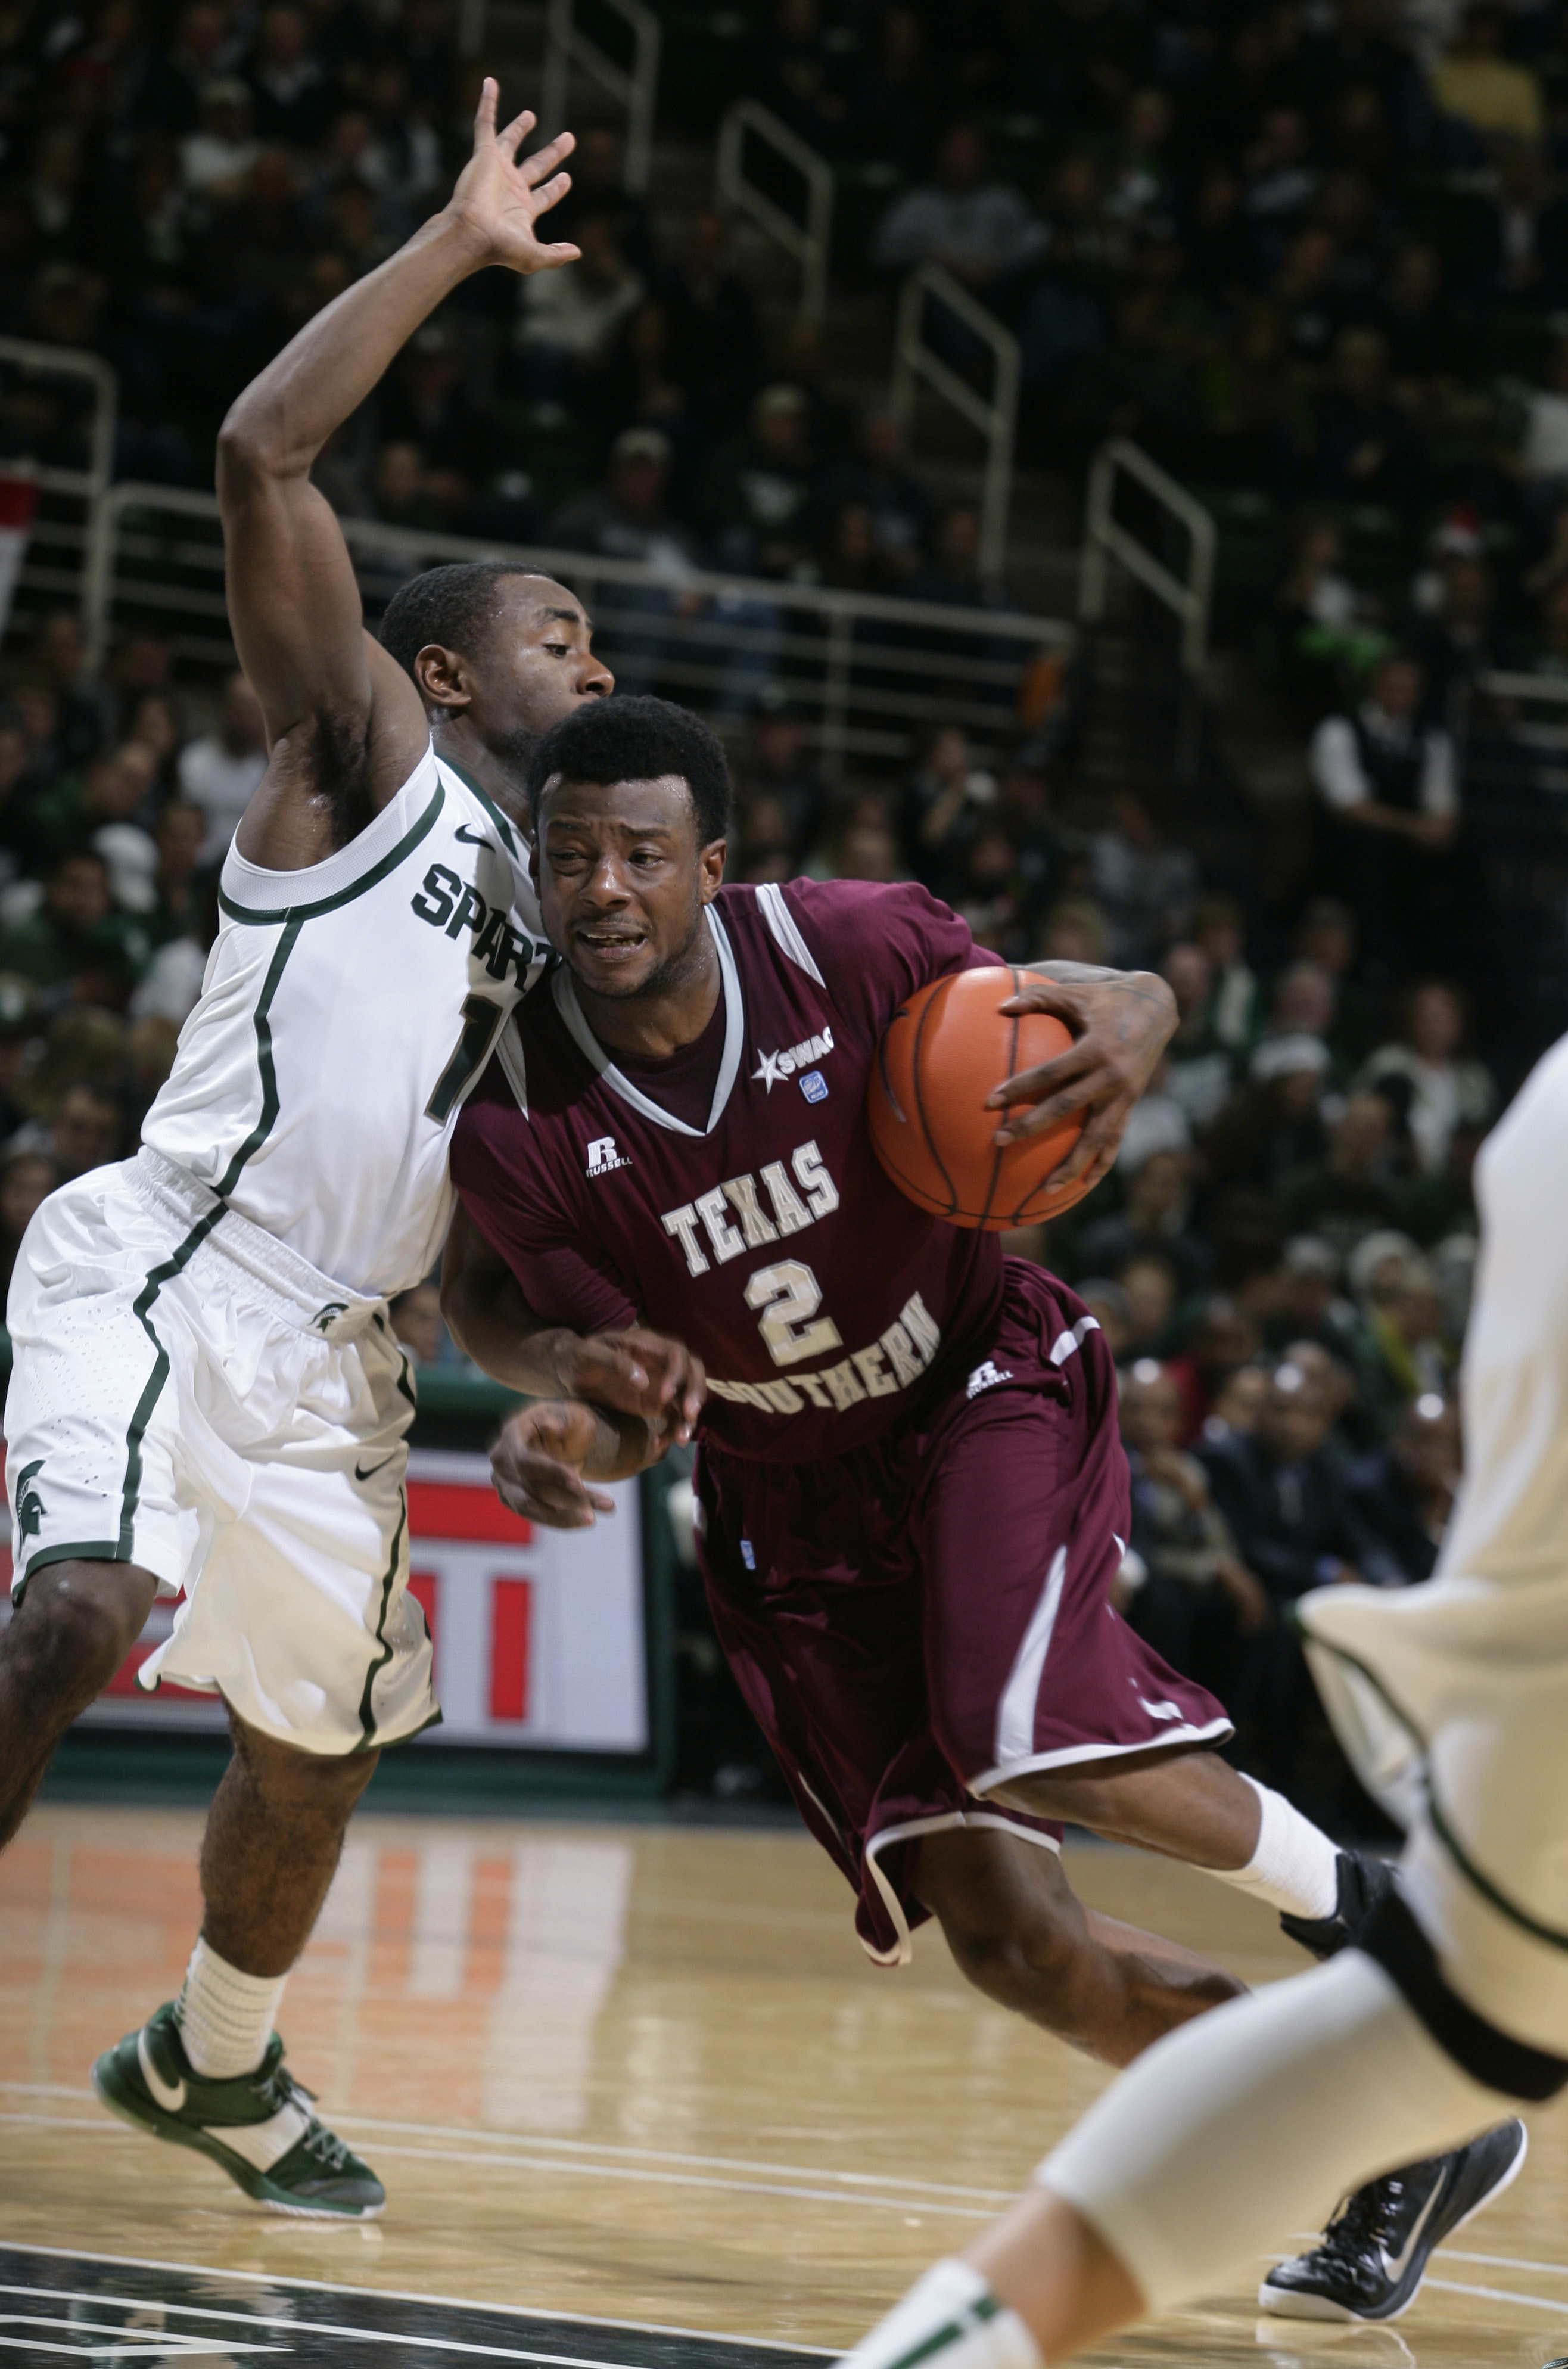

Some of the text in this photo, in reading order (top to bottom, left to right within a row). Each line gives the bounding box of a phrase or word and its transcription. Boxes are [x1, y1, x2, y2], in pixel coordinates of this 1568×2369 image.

[777, 1026, 834, 1074] SWAC
[586, 1156, 633, 1178] RUSSELL
[661, 1139, 839, 1278] TEXAS
[743, 1258, 843, 1366] 2
